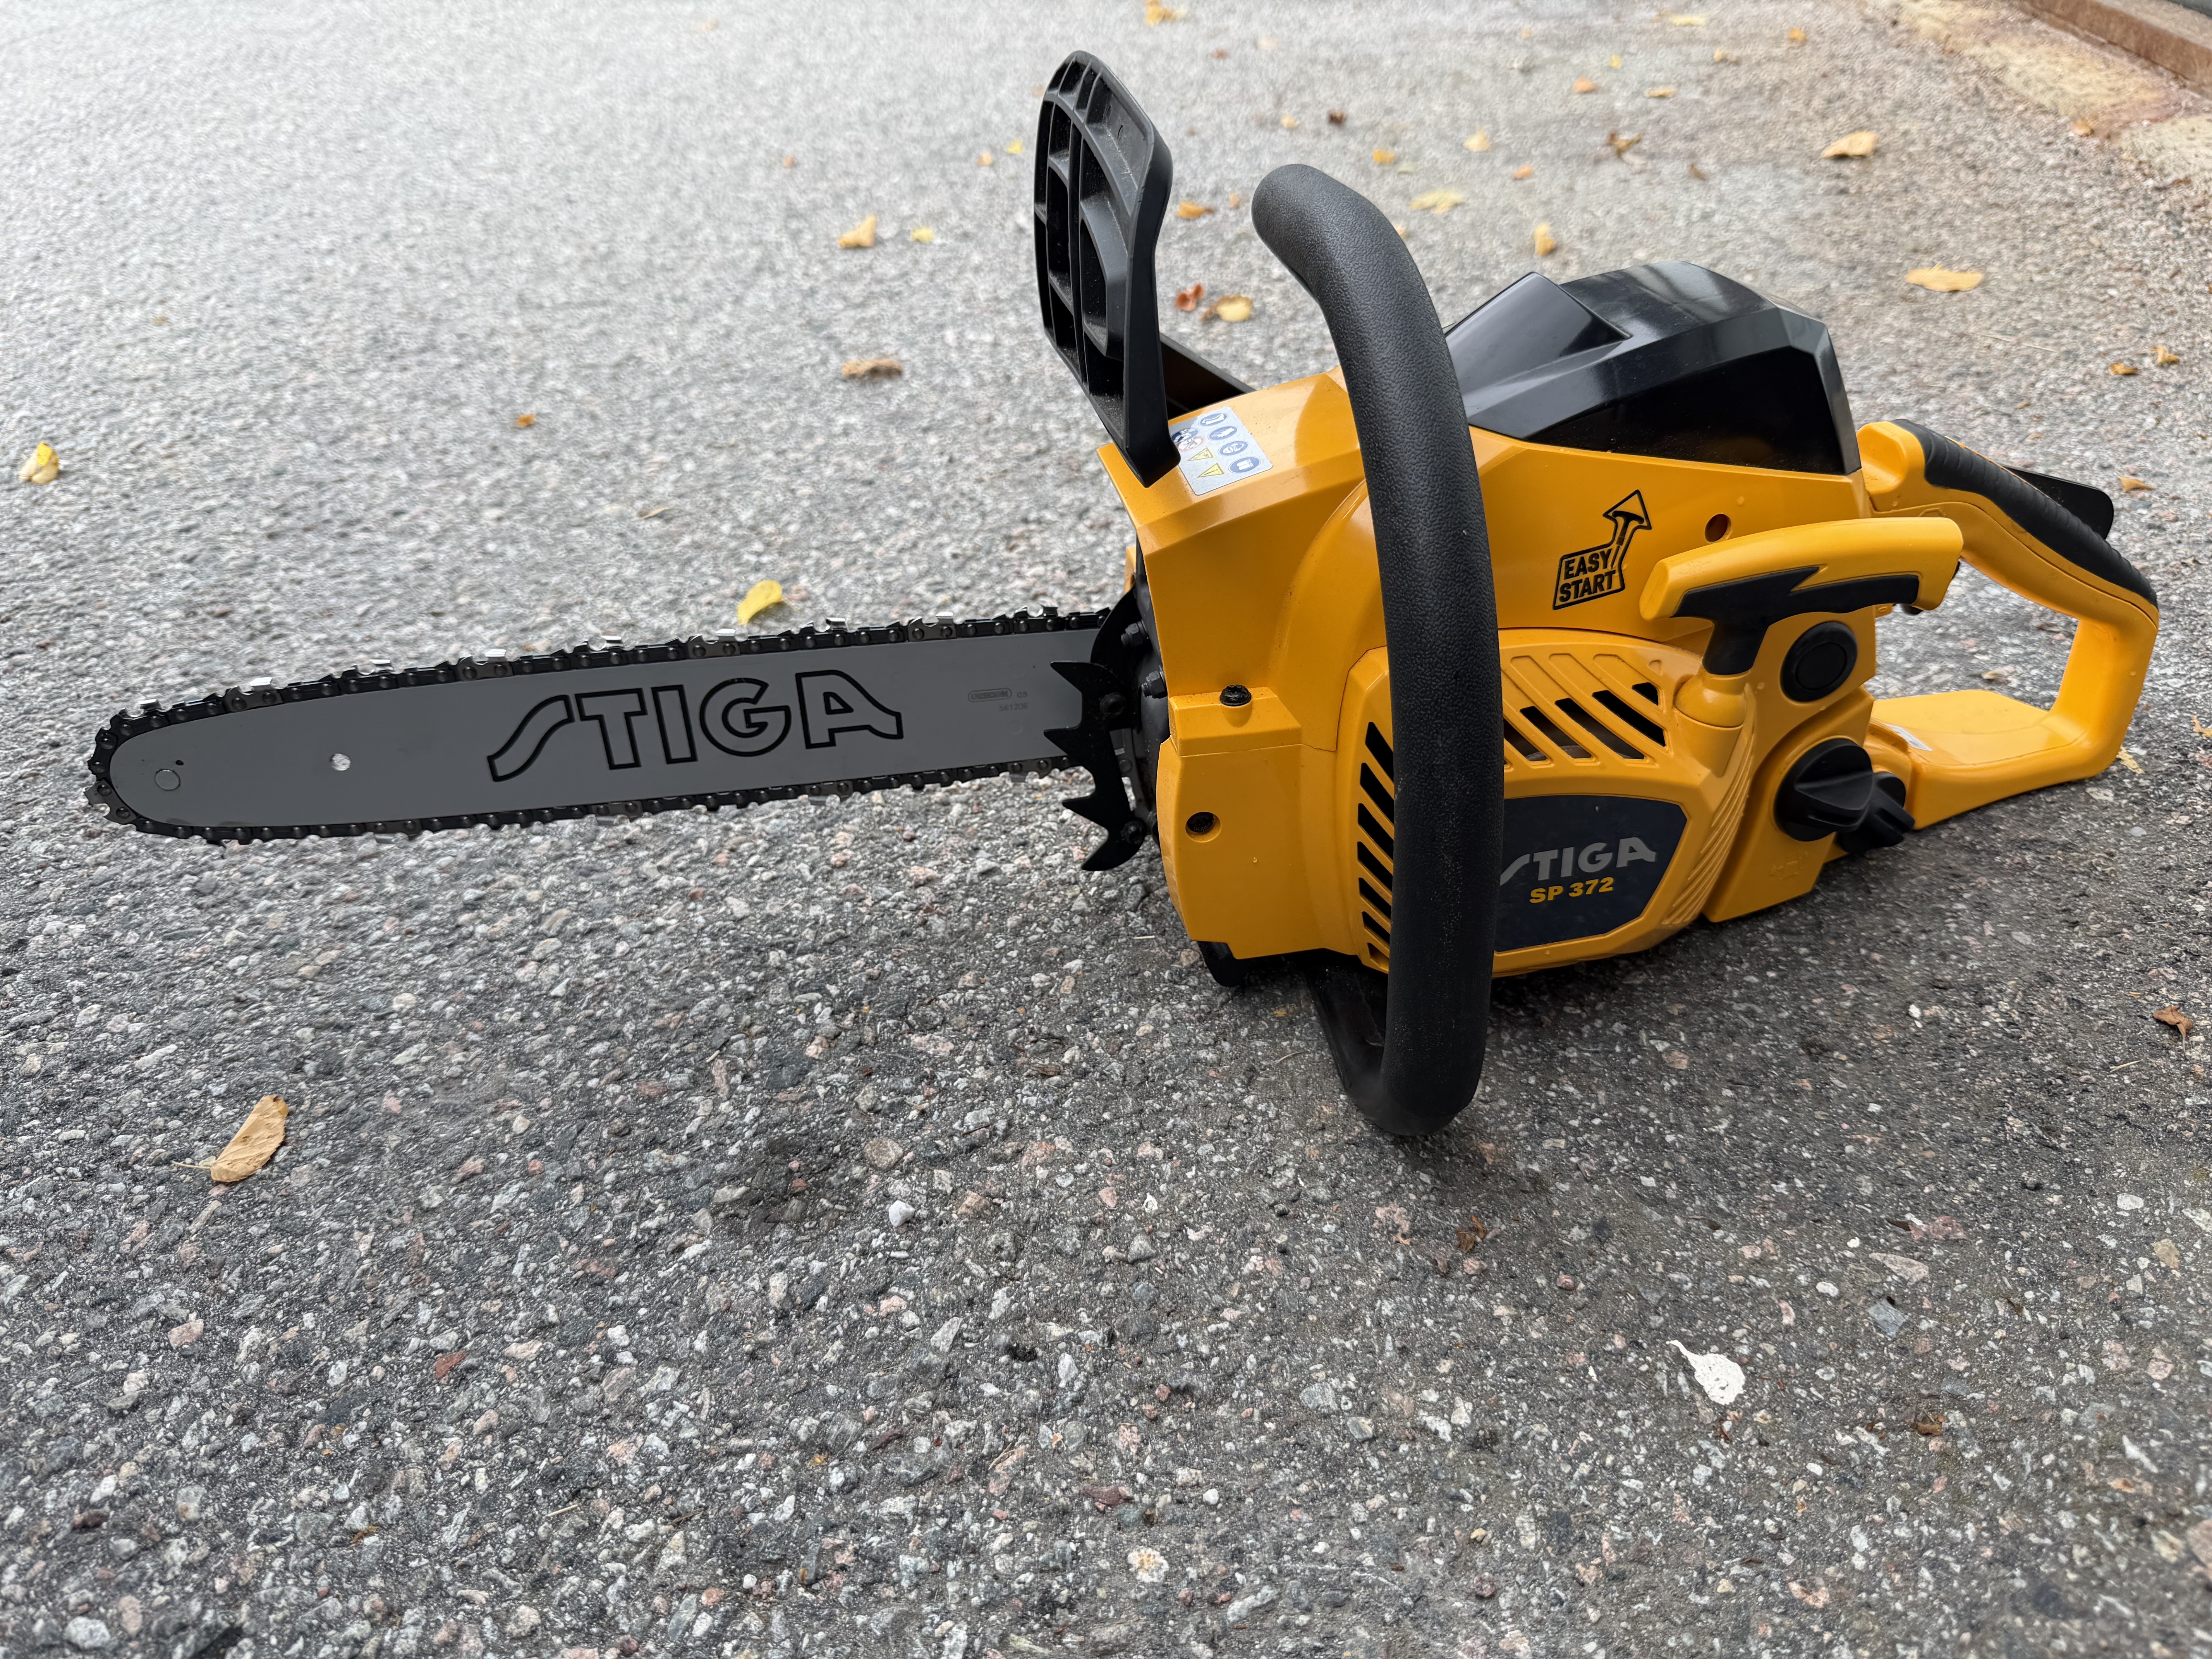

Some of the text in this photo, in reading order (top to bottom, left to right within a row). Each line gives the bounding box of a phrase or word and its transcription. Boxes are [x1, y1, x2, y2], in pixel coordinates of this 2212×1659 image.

[1564, 548, 1612, 580] EASY
[1559, 570, 1616, 602] START
[487, 670, 903, 781] STIGA
[1500, 837, 1656, 886] STIGA
[1529, 877, 1614, 904] SP 372
